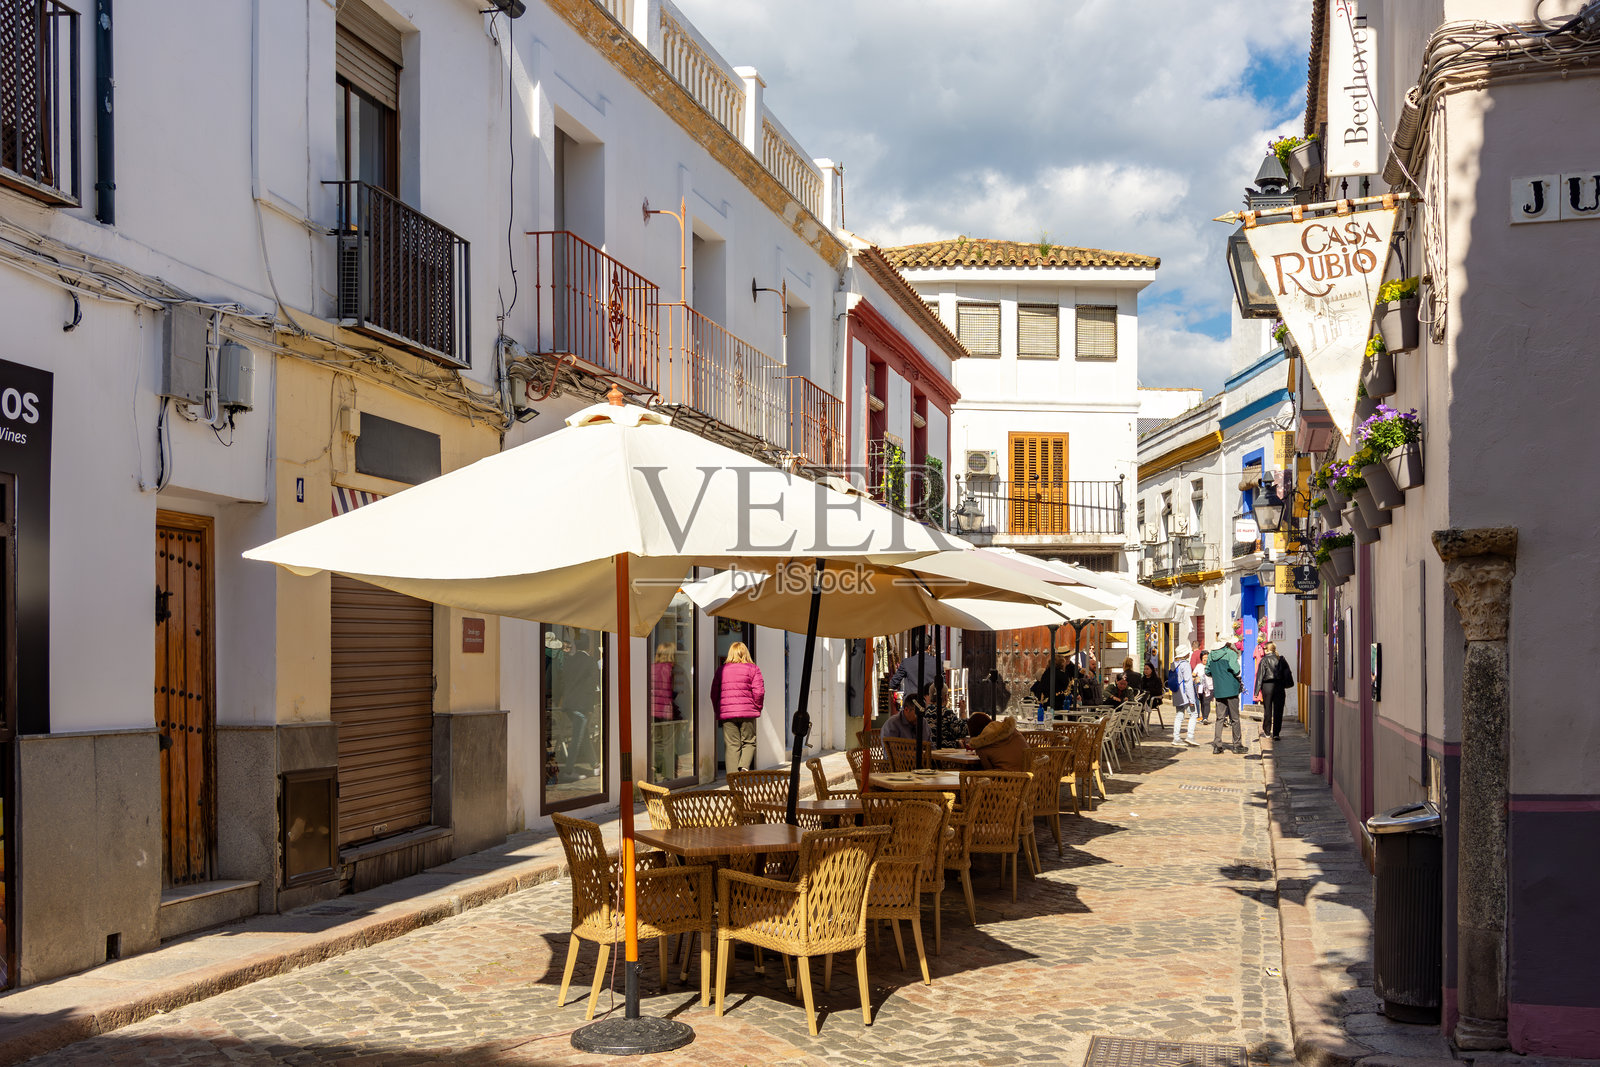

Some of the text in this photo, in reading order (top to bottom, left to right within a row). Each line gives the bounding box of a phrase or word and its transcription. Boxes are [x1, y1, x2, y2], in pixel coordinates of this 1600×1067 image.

[1344, 13, 1368, 147] Beethoven
[1523, 175, 1600, 214] JU
[1301, 221, 1382, 254] CASA
[1271, 247, 1377, 297] RUBIO
[1, 387, 39, 424] OS
[296, 480, 303, 500] 4
